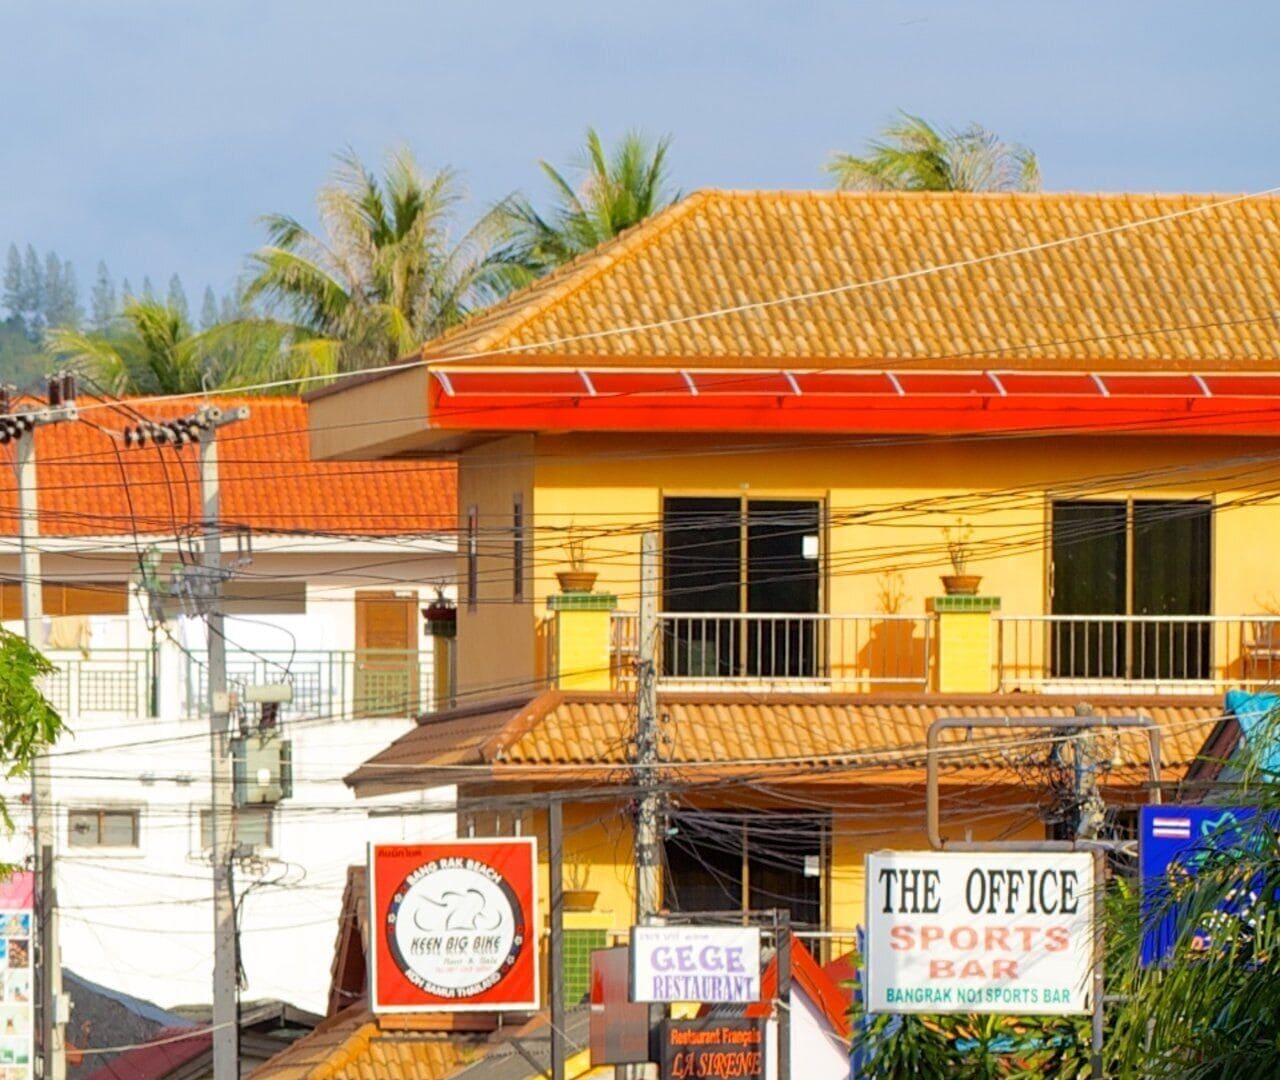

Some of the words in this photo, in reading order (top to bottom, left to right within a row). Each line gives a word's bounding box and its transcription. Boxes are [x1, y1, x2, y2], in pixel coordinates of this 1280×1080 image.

[406, 860, 438, 886] BANG
[440, 857, 464, 869] RAK
[466, 858, 503, 884] BEACH
[878, 868, 941, 914] THE
[966, 868, 1079, 915] OFFICE
[410, 936, 442, 951] KEEN
[445, 936, 469, 950] BIG
[472, 936, 503, 949] BIKE
[890, 925, 1071, 952] SPORTS
[650, 945, 746, 972] GEGE
[929, 959, 1019, 979] BAR
[653, 974, 754, 1000] RESTAURANT
[886, 988, 952, 1003] BANGRAK
[986, 988, 1038, 1004] SPORTS
[1043, 988, 1071, 1003] BAR
[671, 1028, 721, 1045] Restaurant
[671, 1052, 695, 1079] LA
[696, 1051, 762, 1079] SIRENE
